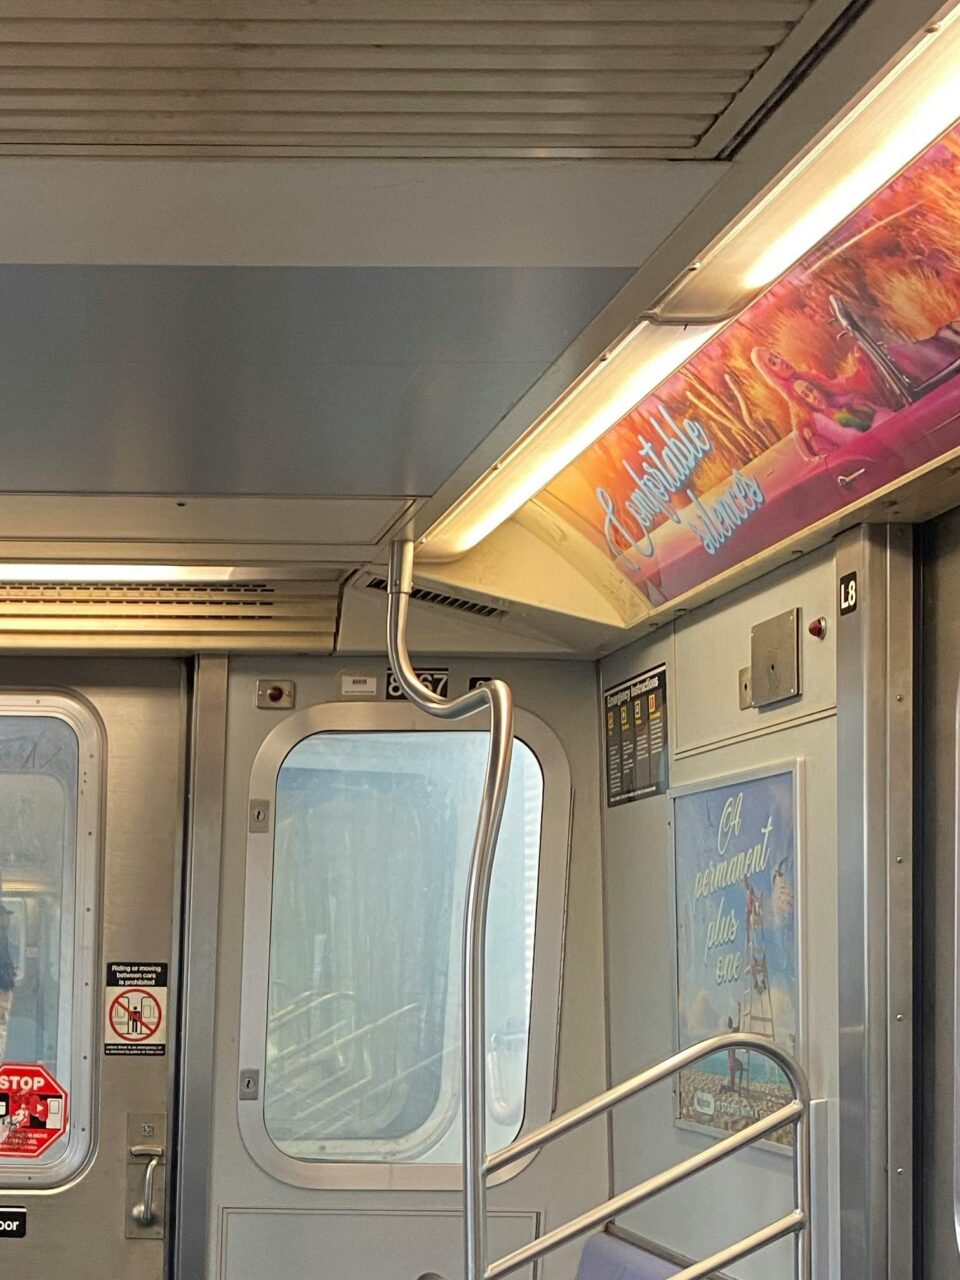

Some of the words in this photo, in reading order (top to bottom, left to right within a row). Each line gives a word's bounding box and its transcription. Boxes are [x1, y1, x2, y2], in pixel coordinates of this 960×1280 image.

[595, 404, 713, 571] Comfortable
[689, 468, 765, 555] silences
[841, 580, 856, 609] L8
[388, 674, 448, 697] 867
[607, 690, 631, 708] Emergency
[631, 676, 659, 697] Instructions
[717, 792, 743, 855] A
[693, 816, 773, 916] permanent
[704, 897, 739, 966] plus
[111, 965, 131, 973] Riding
[139, 965, 161, 973] moving
[716, 952, 742, 986] one
